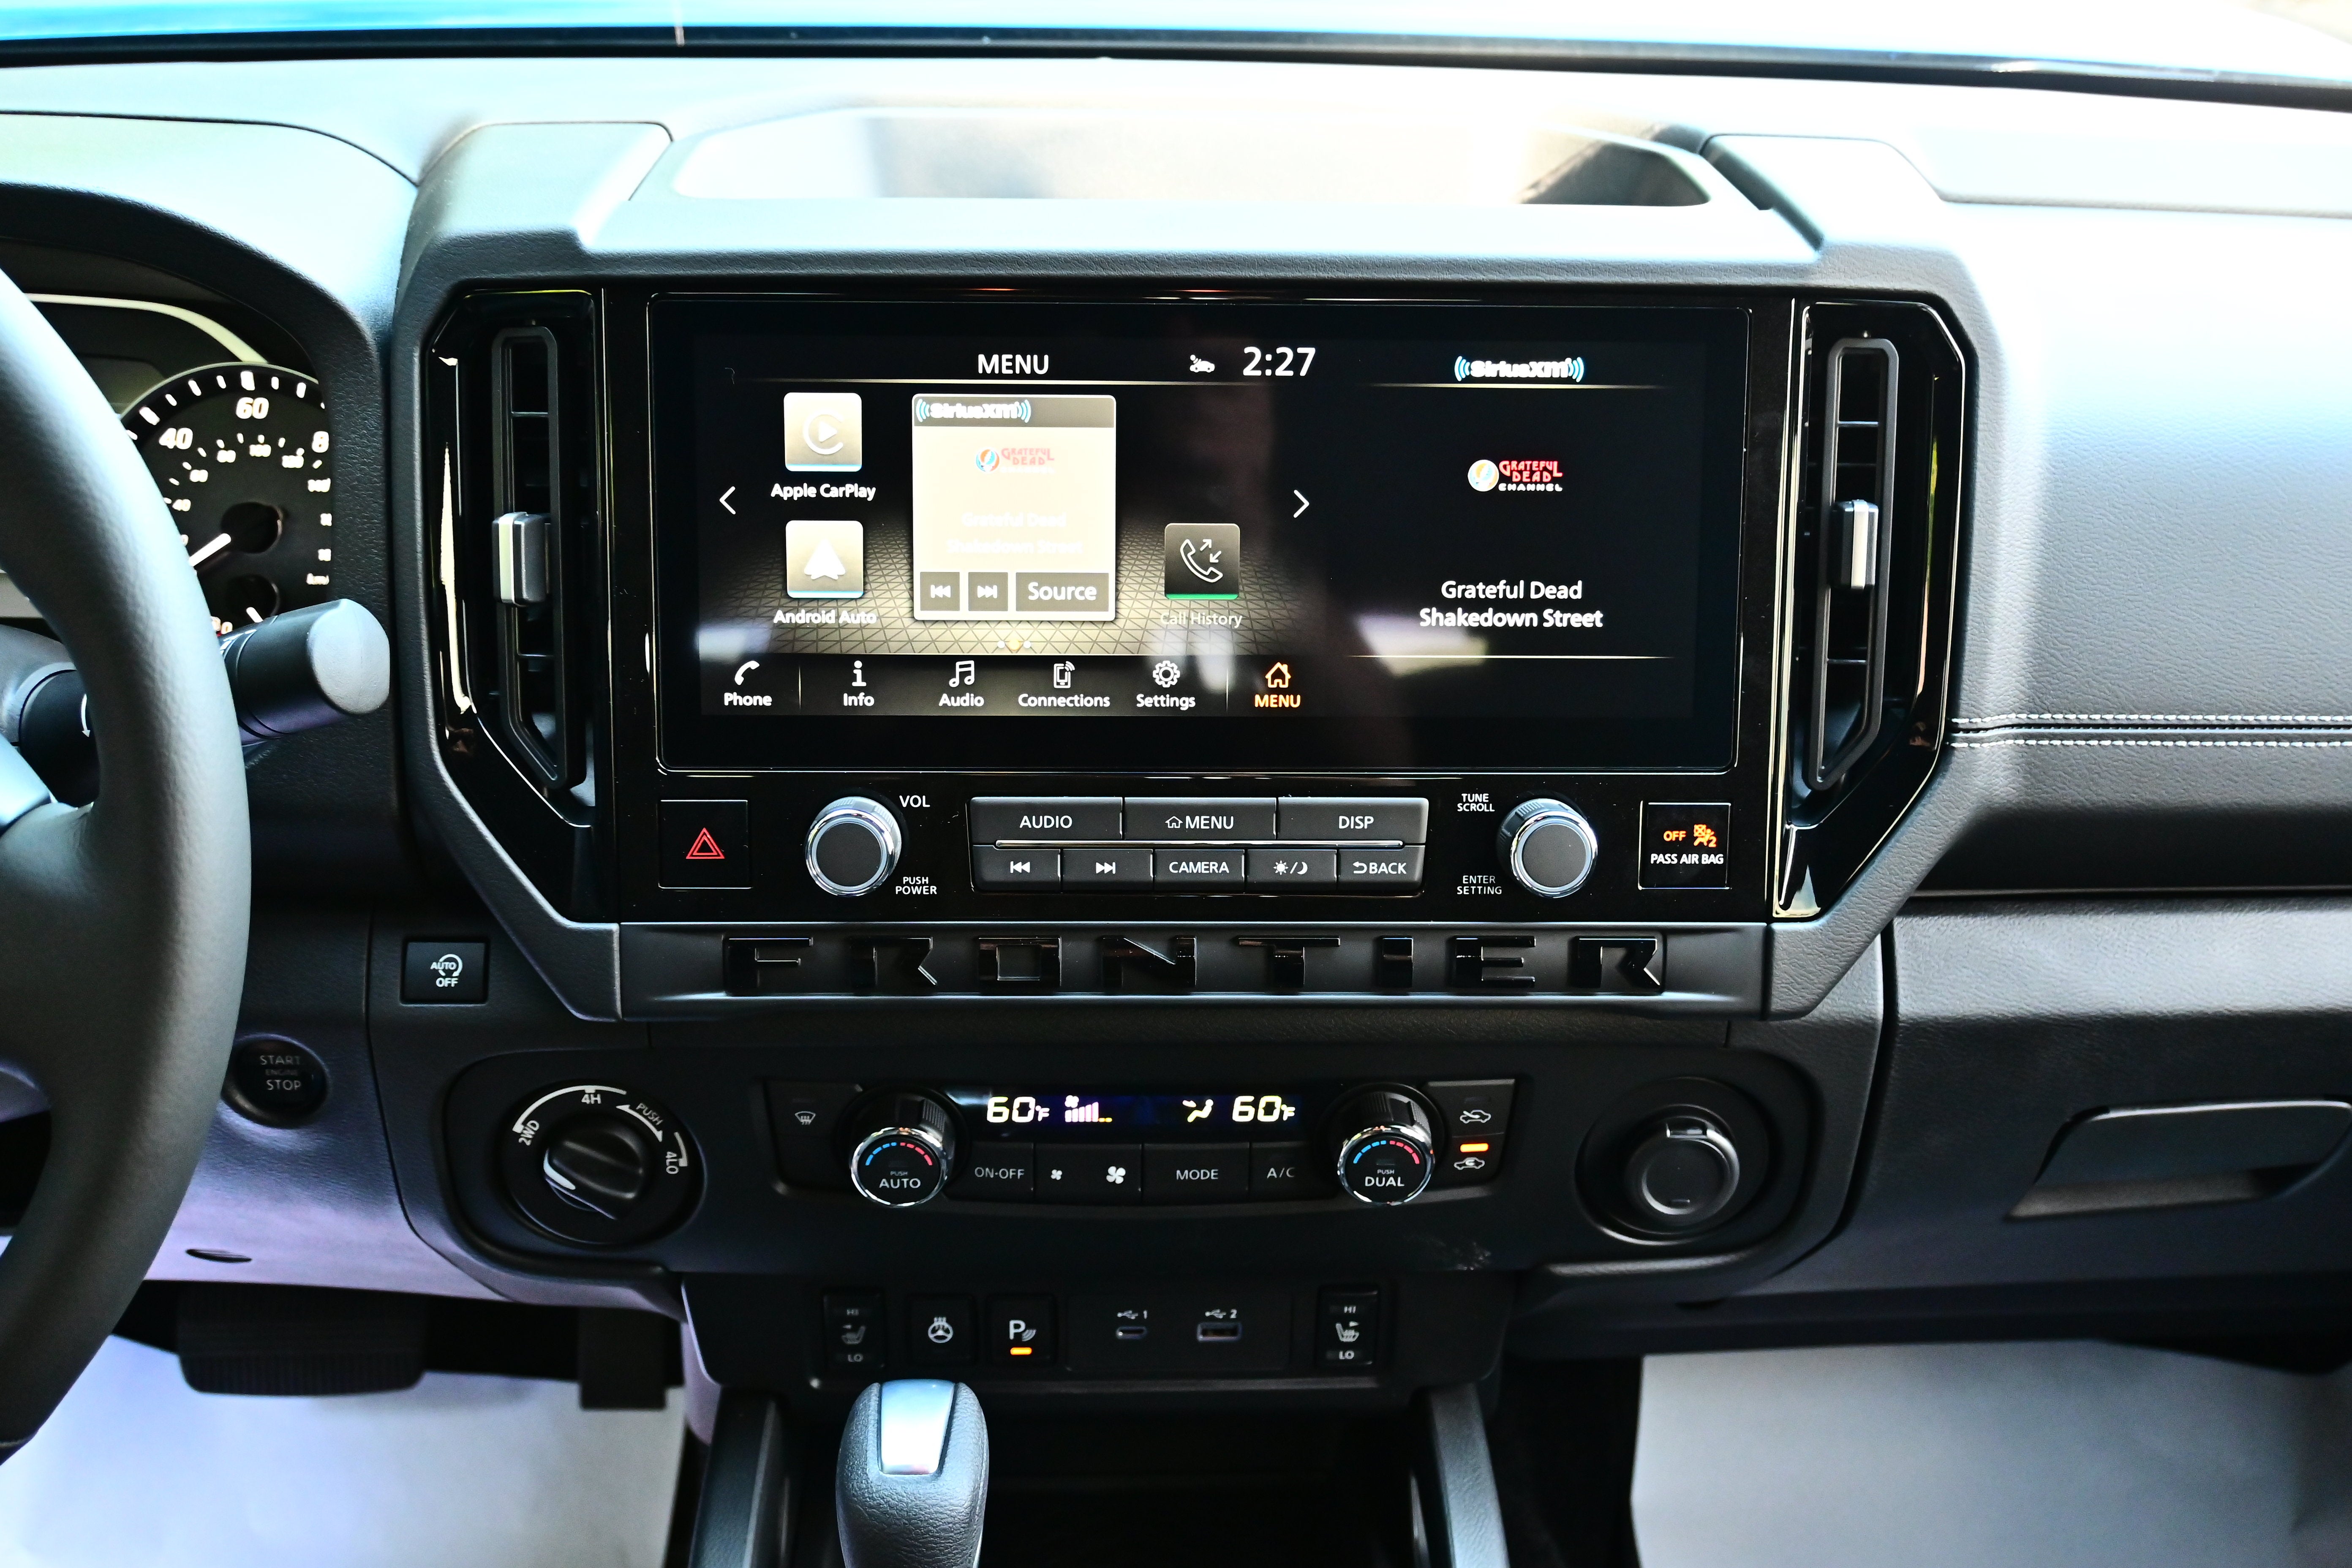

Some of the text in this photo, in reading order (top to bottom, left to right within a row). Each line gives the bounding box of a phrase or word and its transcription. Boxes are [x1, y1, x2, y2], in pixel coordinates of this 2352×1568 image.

[978, 354, 1049, 375] MENU
[1243, 346, 1316, 376] 2:27
[236, 397, 269, 419] 60
[158, 427, 193, 450] 40
[311, 431, 329, 453] 8
[1001, 448, 1054, 461] GRATEFUL
[1013, 457, 1045, 465] DEAD
[1499, 460, 1563, 477] GRATEFUL
[1512, 471, 1551, 482] DEAD
[770, 482, 876, 501] Apple CarPlay
[1498, 483, 1563, 492] CHANNEL
[1028, 582, 1097, 601] Source
[1441, 580, 1582, 599] Grateful Dead
[773, 610, 877, 624] Android Auto
[1160, 612, 1243, 628] Call History
[1420, 607, 1603, 628] Shakedown Street
[724, 692, 772, 706] Phone
[843, 692, 875, 707] Info
[938, 692, 985, 707] Audio
[1018, 694, 1111, 708] Connections
[1136, 694, 1196, 710] Settings
[1255, 694, 1301, 708] MENU
[899, 795, 931, 808] VOL
[1461, 793, 1489, 802] TUNE
[1457, 803, 1495, 812] SCROLL
[1019, 815, 1073, 828] AUDIO
[1186, 815, 1234, 829] MENU
[1339, 816, 1374, 829] DISP
[1663, 830, 1687, 841] OFF
[1650, 853, 1724, 864] PASS AIR BAG
[1169, 861, 1230, 874] CAMERA
[1369, 862, 1407, 874] BACK
[903, 877, 928, 885] PUSH
[1462, 875, 1495, 884] ENTER
[896, 885, 937, 895] POWER
[1457, 886, 1502, 895] SETTING
[430, 962, 457, 970] AUTO
[723, 935, 1661, 995] FRONTIER
[436, 977, 458, 987] OFF
[260, 1055, 301, 1065] START
[266, 1079, 301, 1090] STOP
[581, 1094, 602, 1104] 4H
[636, 1102, 663, 1125] PUSH
[518, 1120, 540, 1146] 2WD
[665, 1152, 679, 1175] 4LO
[975, 1167, 1025, 1180] ON-OFF
[1176, 1169, 1219, 1180] MODE
[1267, 1167, 1296, 1179] A/C
[879, 1178, 921, 1189] AUTO
[1364, 1176, 1405, 1187] DUAL
[1143, 1310, 1147, 1319] 1
[1230, 1309, 1238, 1318] 2
[847, 1353, 863, 1362] LO
[1339, 1350, 1355, 1360] LO
